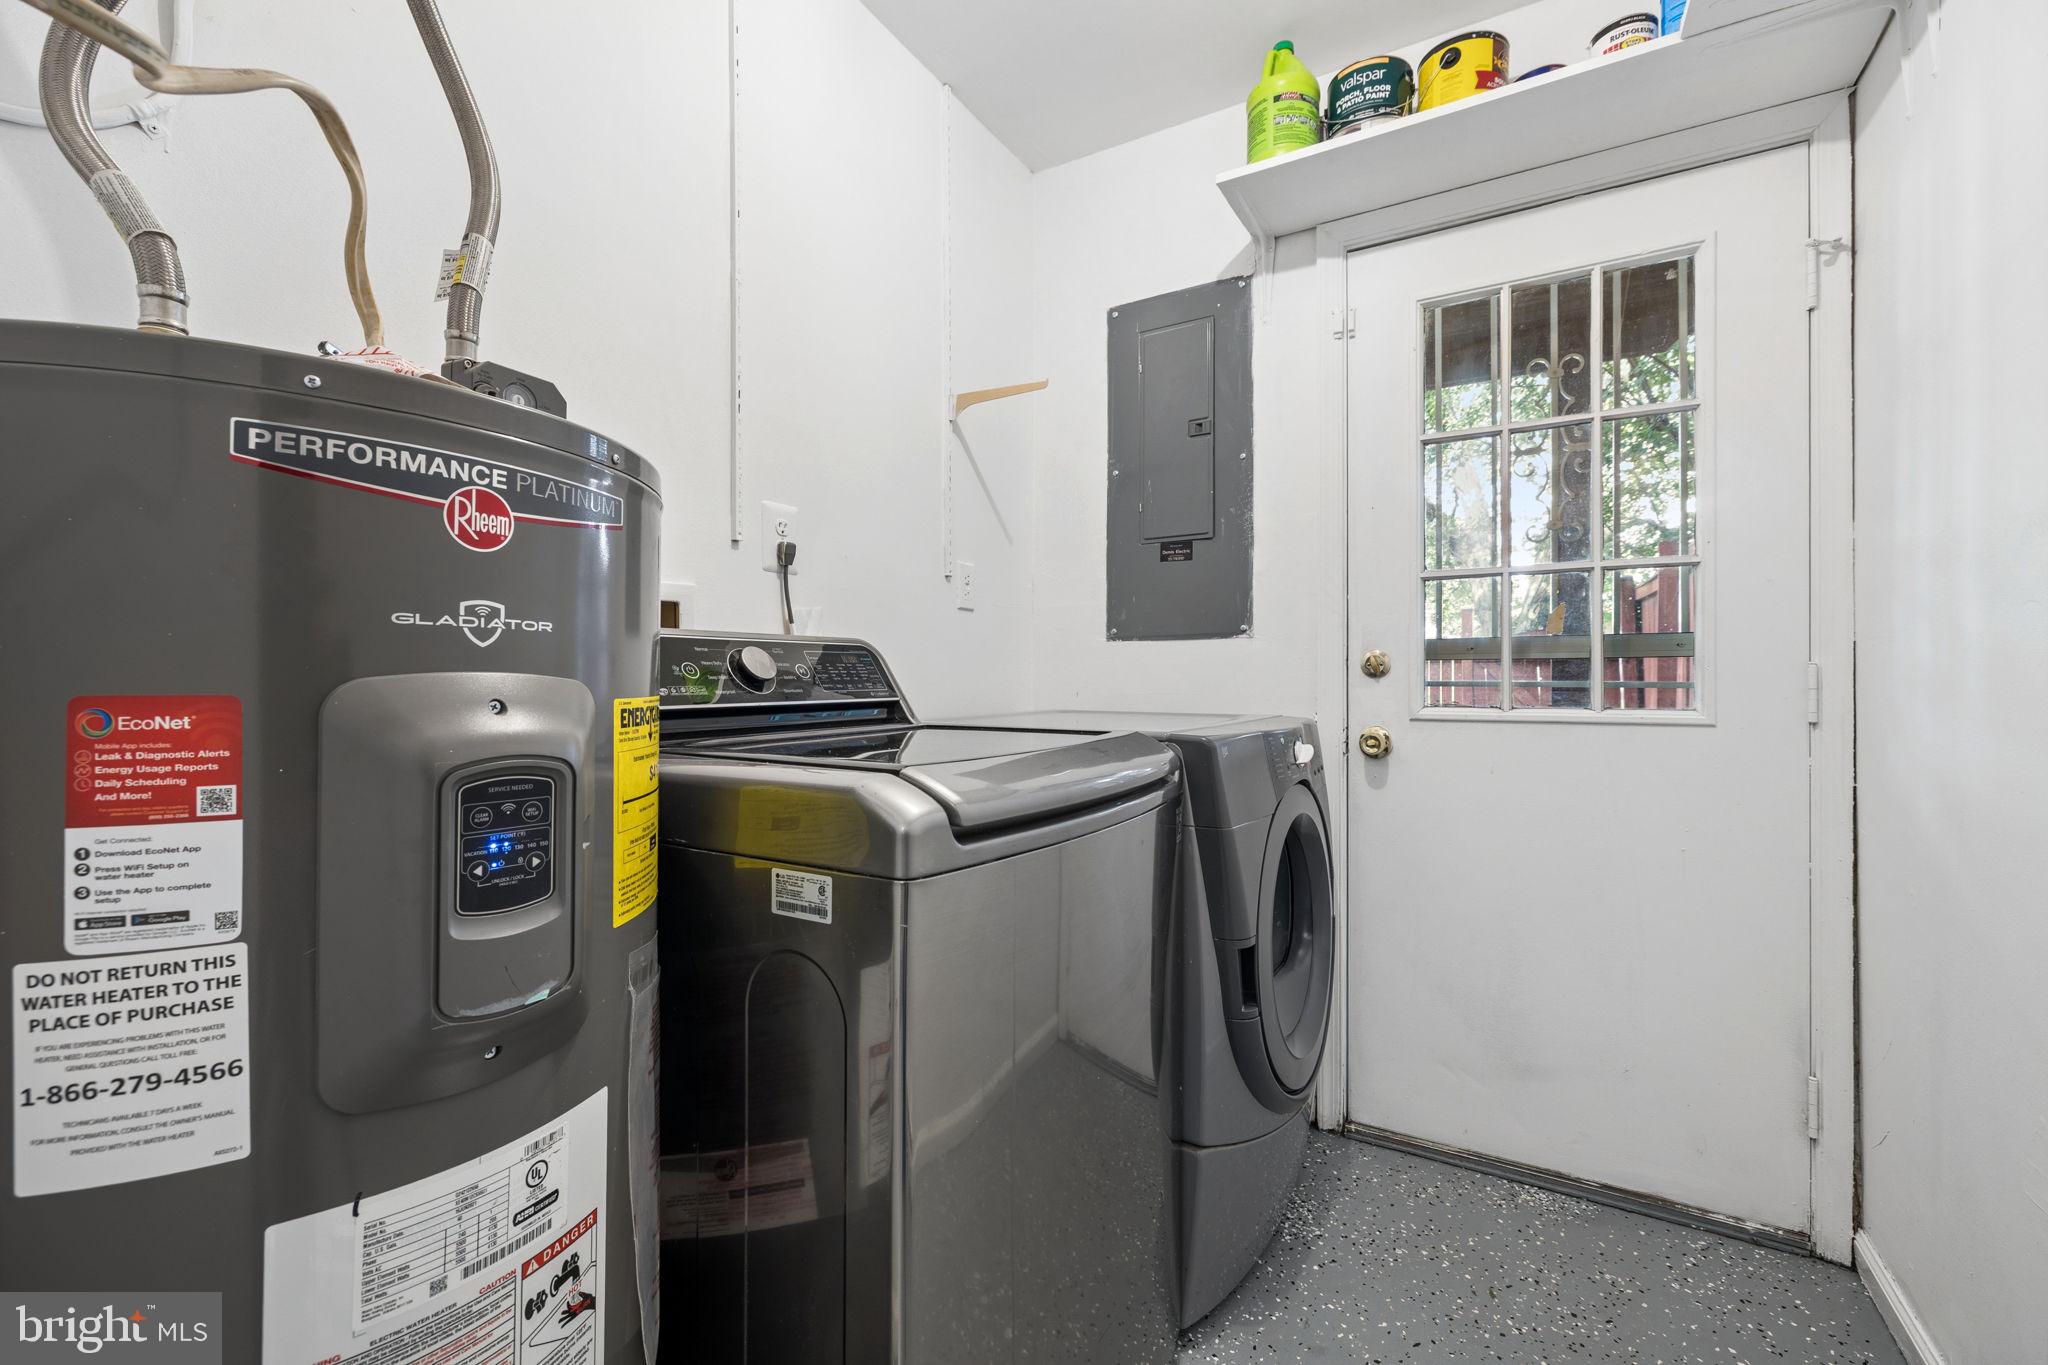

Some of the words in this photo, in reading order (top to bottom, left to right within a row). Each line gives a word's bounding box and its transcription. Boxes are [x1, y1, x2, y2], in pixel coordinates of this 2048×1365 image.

[1609, 27, 1654, 43] RUST-OLEUM
[1340, 69, 1388, 92] valspar
[1336, 89, 1362, 107] PORCH,
[1364, 84, 1391, 94] FLOOR
[1342, 96, 1364, 110] PATIO
[1366, 92, 1390, 100] PAINT
[247, 426, 509, 490] PERFORMANCE
[516, 473, 617, 518] PLATINUM
[453, 489, 510, 541] Rheem
[391, 611, 553, 633] GLADIATOR
[118, 716, 192, 731] EcoNet
[94, 752, 122, 760] Leak
[124, 752, 133, 760] &
[136, 751, 195, 760] Diagnostic
[198, 750, 230, 758] Alerts
[94, 766, 133, 775] Energy
[137, 764, 172, 773] Usage
[175, 763, 219, 772] Reports
[94, 779, 122, 788] Daily
[125, 777, 187, 786] Scheduling
[94, 793, 116, 801] And
[120, 792, 152, 800] More!
[94, 849, 143, 858] Download
[145, 847, 180, 855] EcoNet
[124, 864, 144, 872] WiFi
[147, 863, 174, 871] Setup
[94, 889, 113, 897] Use
[167, 882, 212, 892] complete
[26, 974, 55, 989] DO
[61, 969, 102, 986] NOT
[107, 960, 187, 981] RETURN
[191, 954, 236, 972] THIS
[21, 993, 86, 1011] WATER
[92, 984, 168, 1005] HEATER
[172, 980, 199, 995] TO
[203, 974, 242, 991] THE
[29, 1014, 90, 1033] PLACE
[95, 1011, 122, 1026] OF
[127, 996, 234, 1023] PURCHASE
[126, 1032, 163, 1042] PROBLEMS
[165, 1030, 183, 1038] WITH
[202, 1023, 225, 1032] WATER
[84, 1048, 125, 1058] ASSISTANCE
[99, 1057, 140, 1068] QUESTIONS
[20, 1059, 243, 1107] 1-866-279-4566
[111, 1111, 148, 1121] AVAILABLE
[155, 1106, 175, 1115] DAYS
[182, 1102, 202, 1110] WEEK
[46, 1136, 66, 1144] MORE
[120, 1124, 153, 1134] CONSULT
[204, 1109, 236, 1119] MANUAL
[142, 1135, 166, 1145] WATER
[168, 1130, 195, 1140] HEATER
[532, 1167, 543, 1180] UL
[543, 1214, 594, 1262] DANGER
[479, 1268, 516, 1294] CAUTION
[568, 1280, 583, 1297] HOT
[370, 1327, 405, 1346] ELECTRIC
[406, 1316, 430, 1331] WATER
[431, 1302, 457, 1318] HEATER
